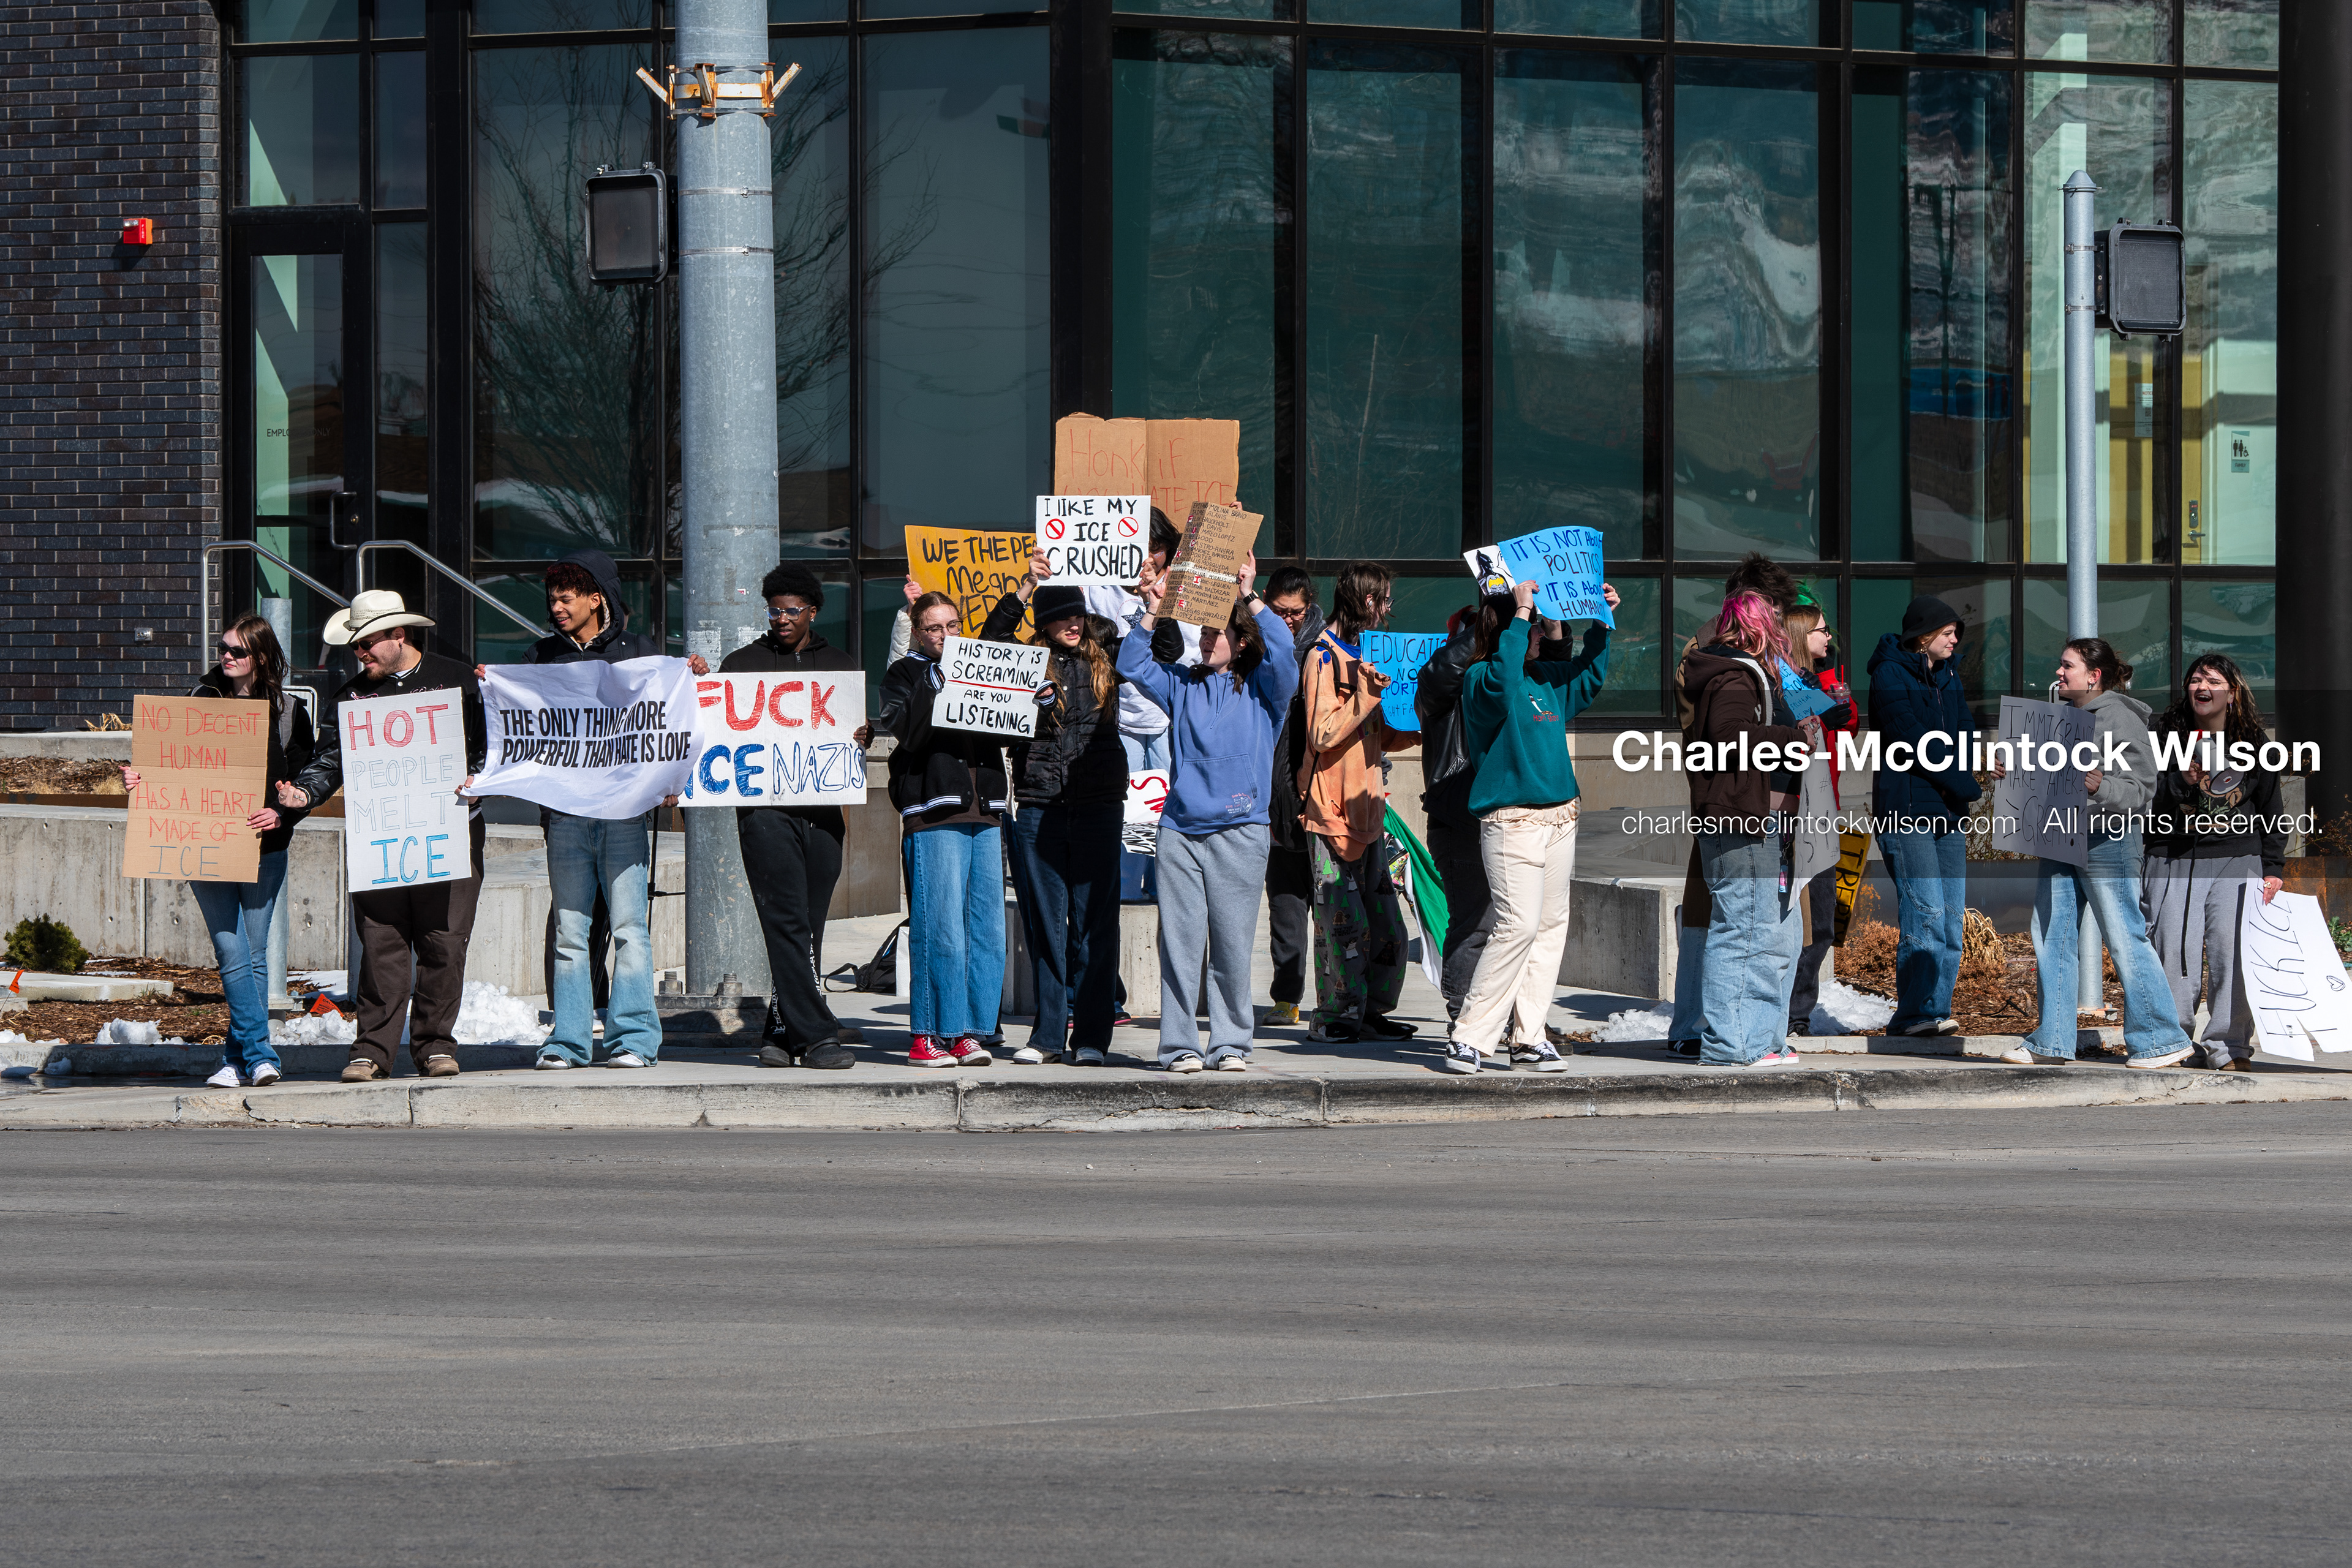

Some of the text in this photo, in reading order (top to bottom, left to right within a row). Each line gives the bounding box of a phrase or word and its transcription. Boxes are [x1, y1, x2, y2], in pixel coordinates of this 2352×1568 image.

[1044, 498, 1051, 517] I
[1107, 497, 1137, 514] MY
[1207, 511, 1227, 521] ALANIS
[1209, 504, 1229, 514] MOLINA
[1231, 510, 1248, 520] BRAVO
[1074, 522, 1109, 541] ICE
[1195, 534, 1213, 543] GOOD
[1200, 529, 1218, 538] MATEO
[1218, 533, 1235, 543] LOPEZ
[1207, 524, 1223, 533] DAVIS
[922, 538, 960, 565] WE
[963, 536, 1010, 564] THE
[1190, 551, 1212, 562] PORTER
[1510, 539, 1529, 562] IT
[1529, 535, 1551, 554] IS
[1553, 529, 1583, 550] NOT
[1047, 545, 1144, 580] CRUSHED
[1201, 560, 1229, 571] MOSQUEDA
[1543, 551, 1602, 576] POLITICS
[1191, 596, 1219, 608] MARTINEZ
[1204, 586, 1231, 597] BALTAZAR
[1212, 594, 1231, 603] VALDEZ
[1545, 581, 1559, 602] IT
[1565, 581, 1578, 598] IS
[1175, 611, 1193, 620] LOPEZ
[1559, 598, 1606, 619] HUMANITY
[958, 642, 1026, 666] HISTORY
[952, 660, 1039, 689] SCREAMING
[963, 689, 1012, 704] ARE YOU
[141, 703, 262, 737] NO DECENT
[347, 703, 449, 751] HOT
[500, 701, 666, 738] THE ONLY THING MORE
[945, 703, 1031, 736] LISTENING
[160, 740, 227, 771] HUMAN
[500, 731, 692, 769] POWERFUL THAN HATE IS LOVE
[352, 754, 453, 791] PEOPLE
[684, 743, 765, 799] CE
[135, 780, 257, 816] HAS A HEART
[354, 791, 456, 834] MELT
[149, 815, 238, 842] MADE OF
[148, 845, 221, 877] ICE
[371, 834, 451, 885] ICE
